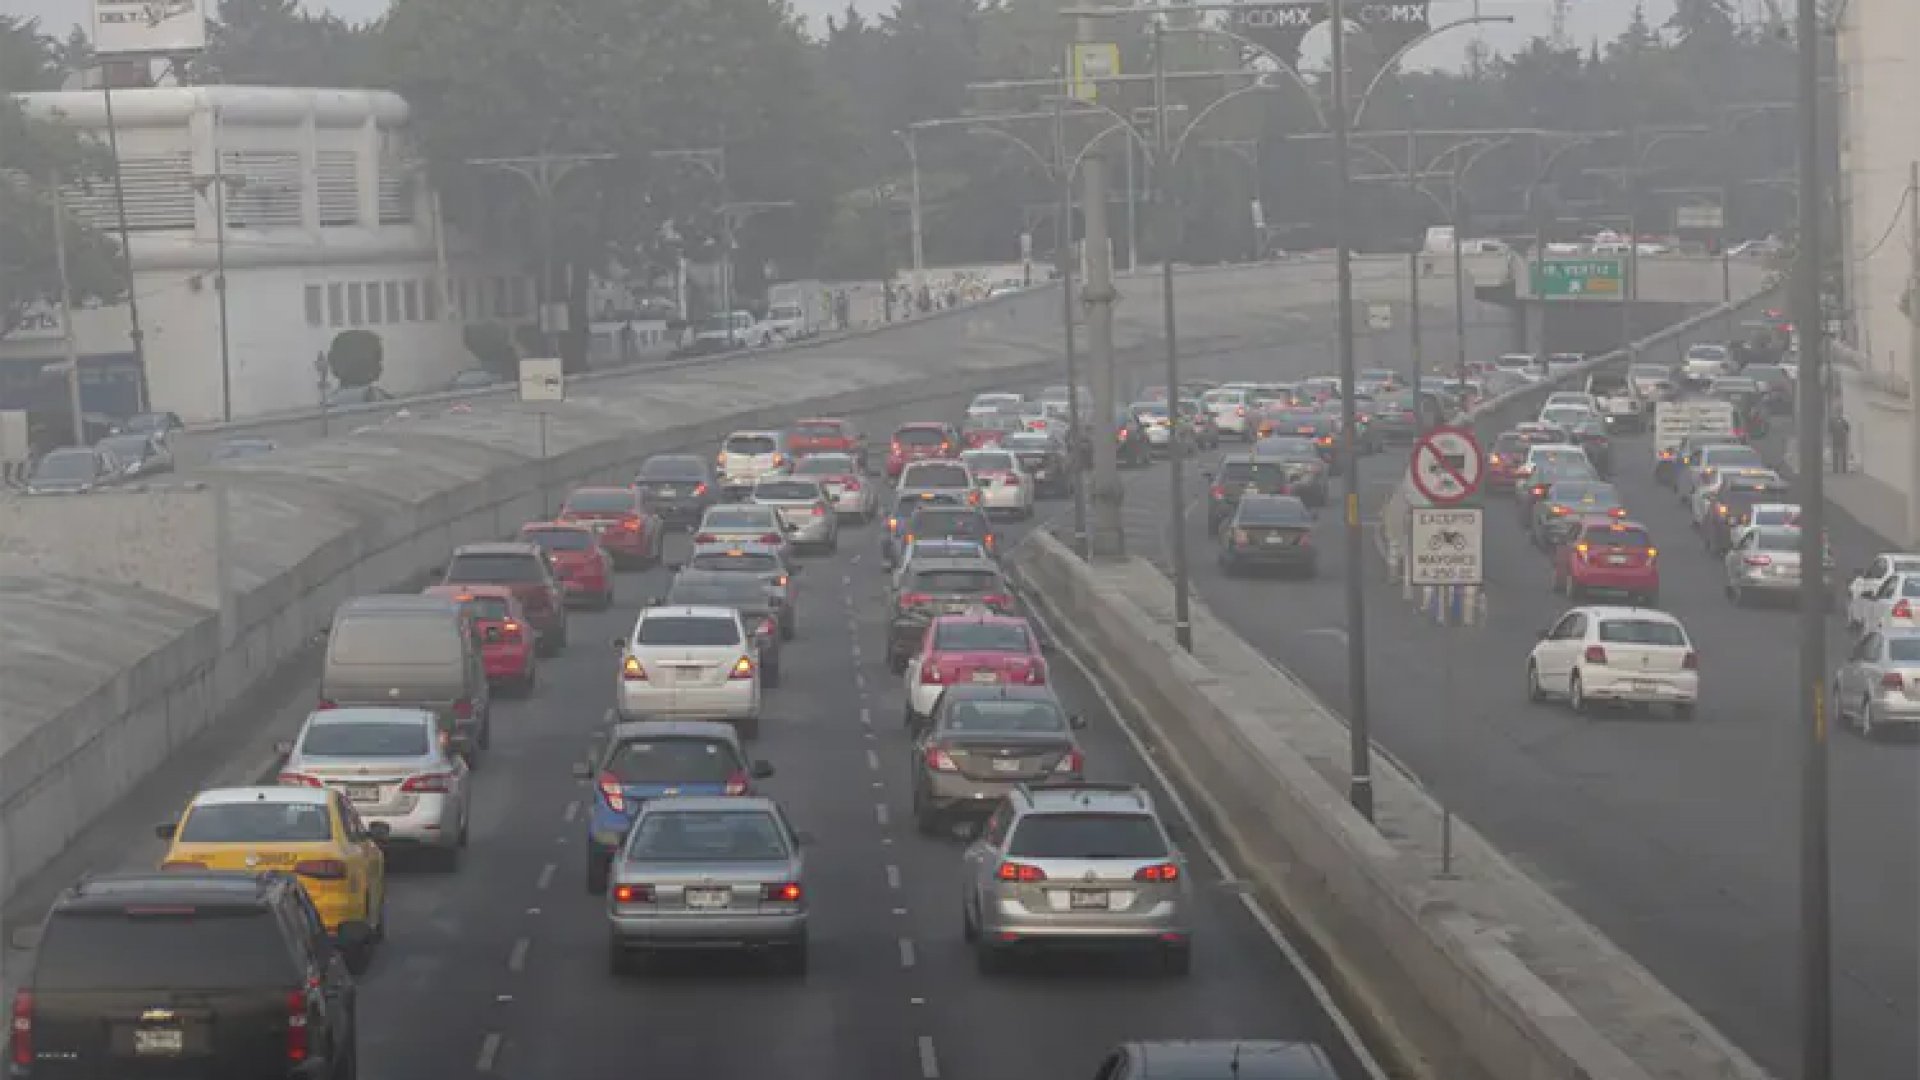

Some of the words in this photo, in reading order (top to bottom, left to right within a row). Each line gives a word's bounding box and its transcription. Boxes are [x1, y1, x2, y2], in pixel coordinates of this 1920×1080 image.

[1248, 7, 1312, 27] CDMX
[1361, 4, 1425, 23] CDMX
[1420, 513, 1475, 525] EXCEPTO
[1417, 554, 1476, 566] MAYORES
